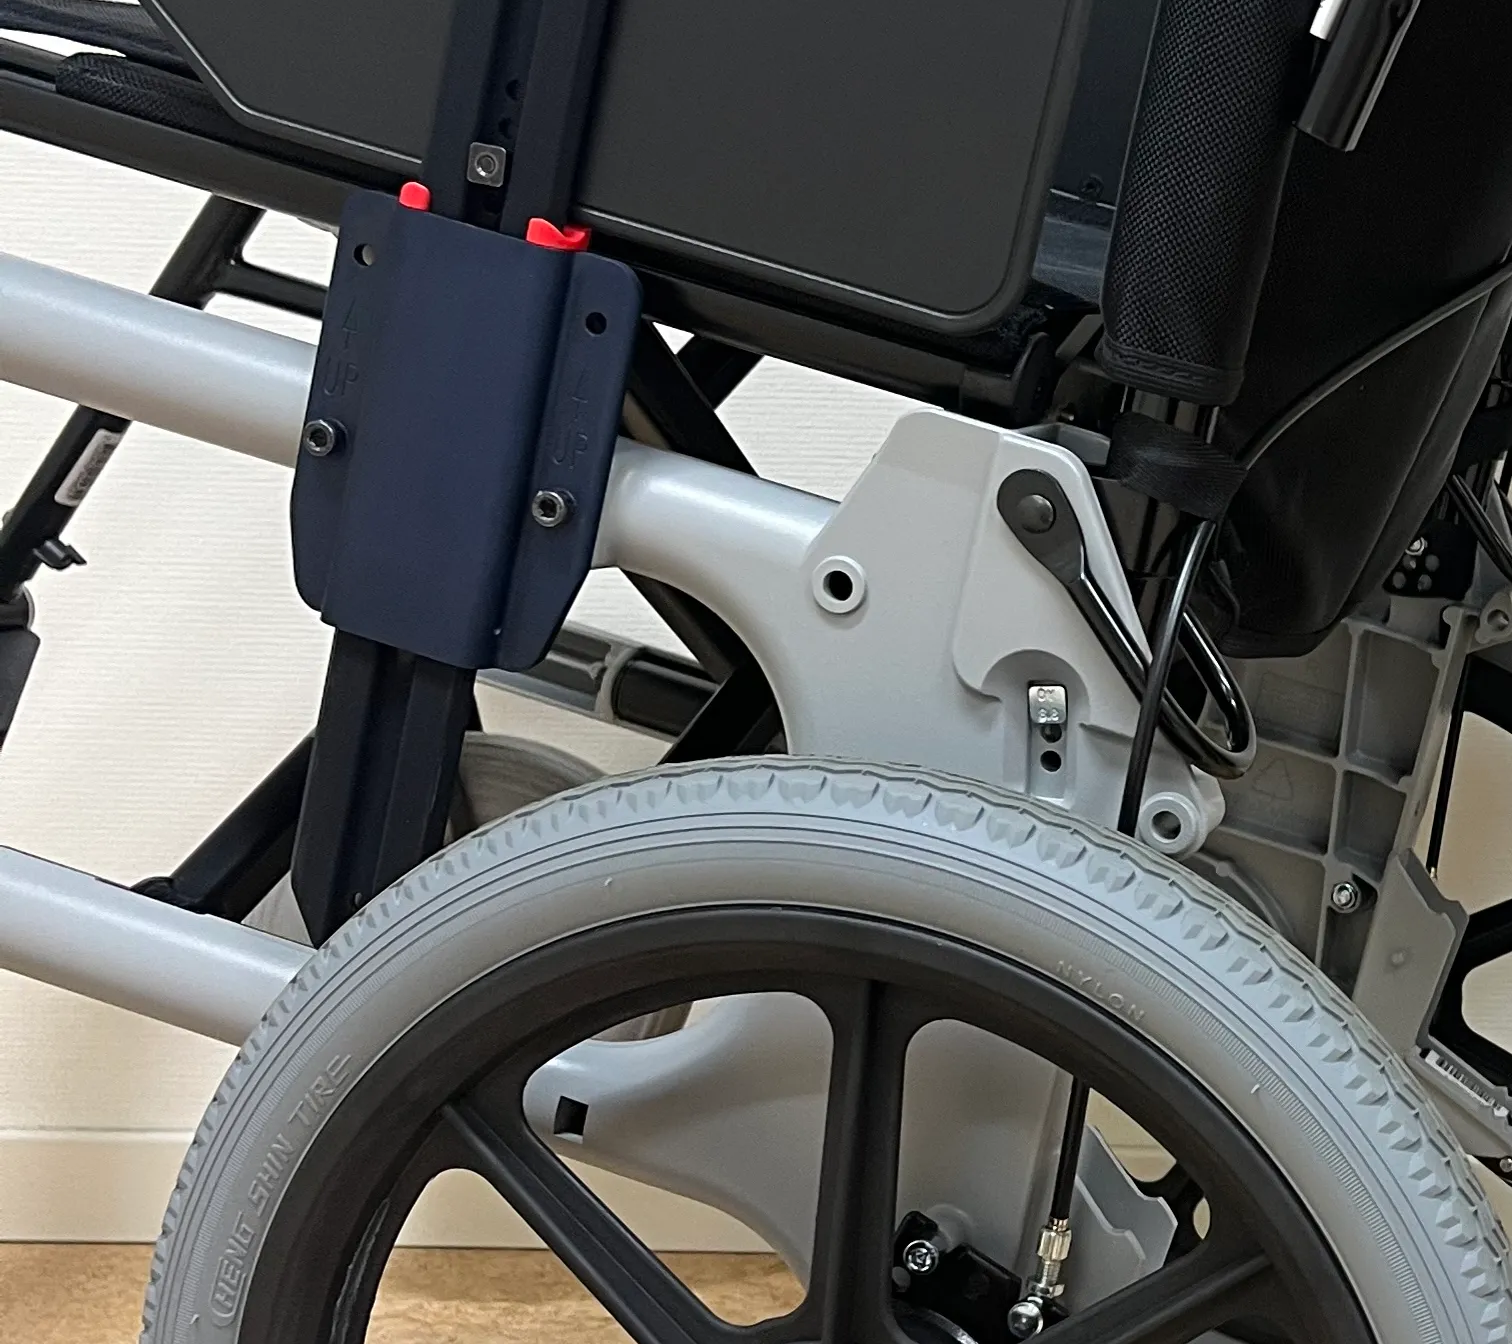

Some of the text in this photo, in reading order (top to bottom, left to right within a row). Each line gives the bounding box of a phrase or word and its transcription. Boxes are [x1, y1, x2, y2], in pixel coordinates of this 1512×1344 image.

[324, 357, 359, 395] UP
[553, 433, 588, 471] UP
[1056, 960, 1145, 1021] NYLON
[249, 1132, 295, 1218] SHIN
[287, 1053, 352, 1127] TIRE
